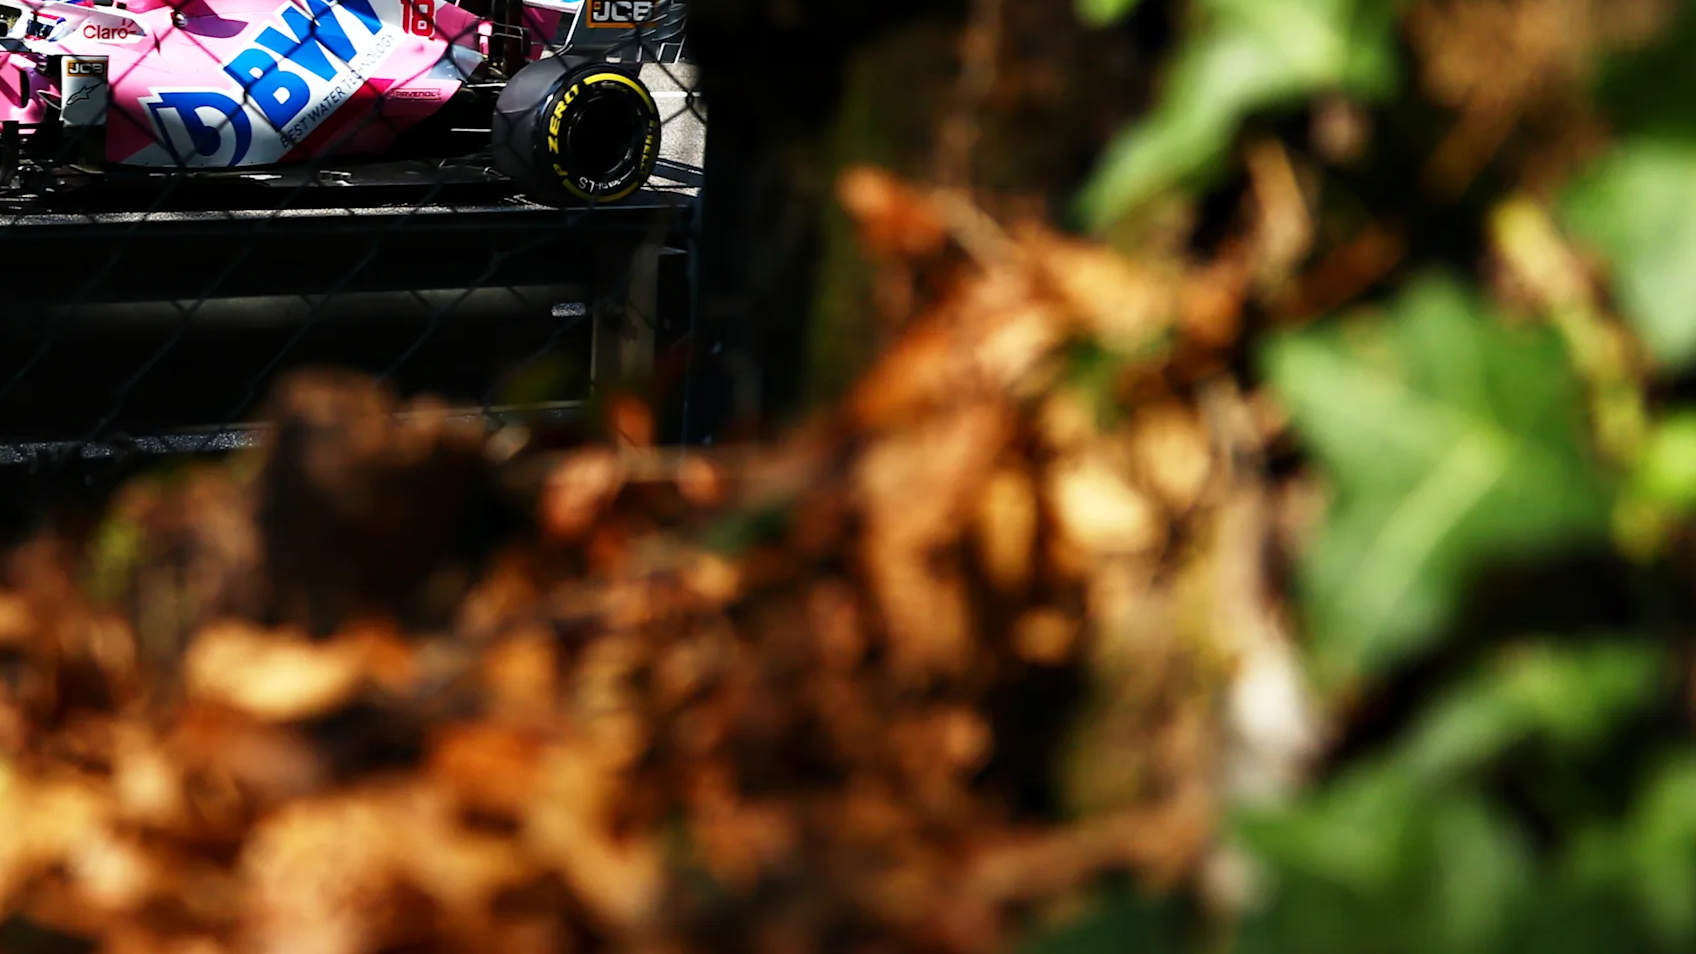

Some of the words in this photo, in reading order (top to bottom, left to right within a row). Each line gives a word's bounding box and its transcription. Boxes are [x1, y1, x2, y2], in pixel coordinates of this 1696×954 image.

[592, 1, 653, 22] JCB
[83, 25, 129, 40] Claro
[68, 62, 104, 74] JCB
[280, 116, 309, 149] BEST
[308, 86, 346, 122] WATER
[547, 84, 579, 154] ZERO
